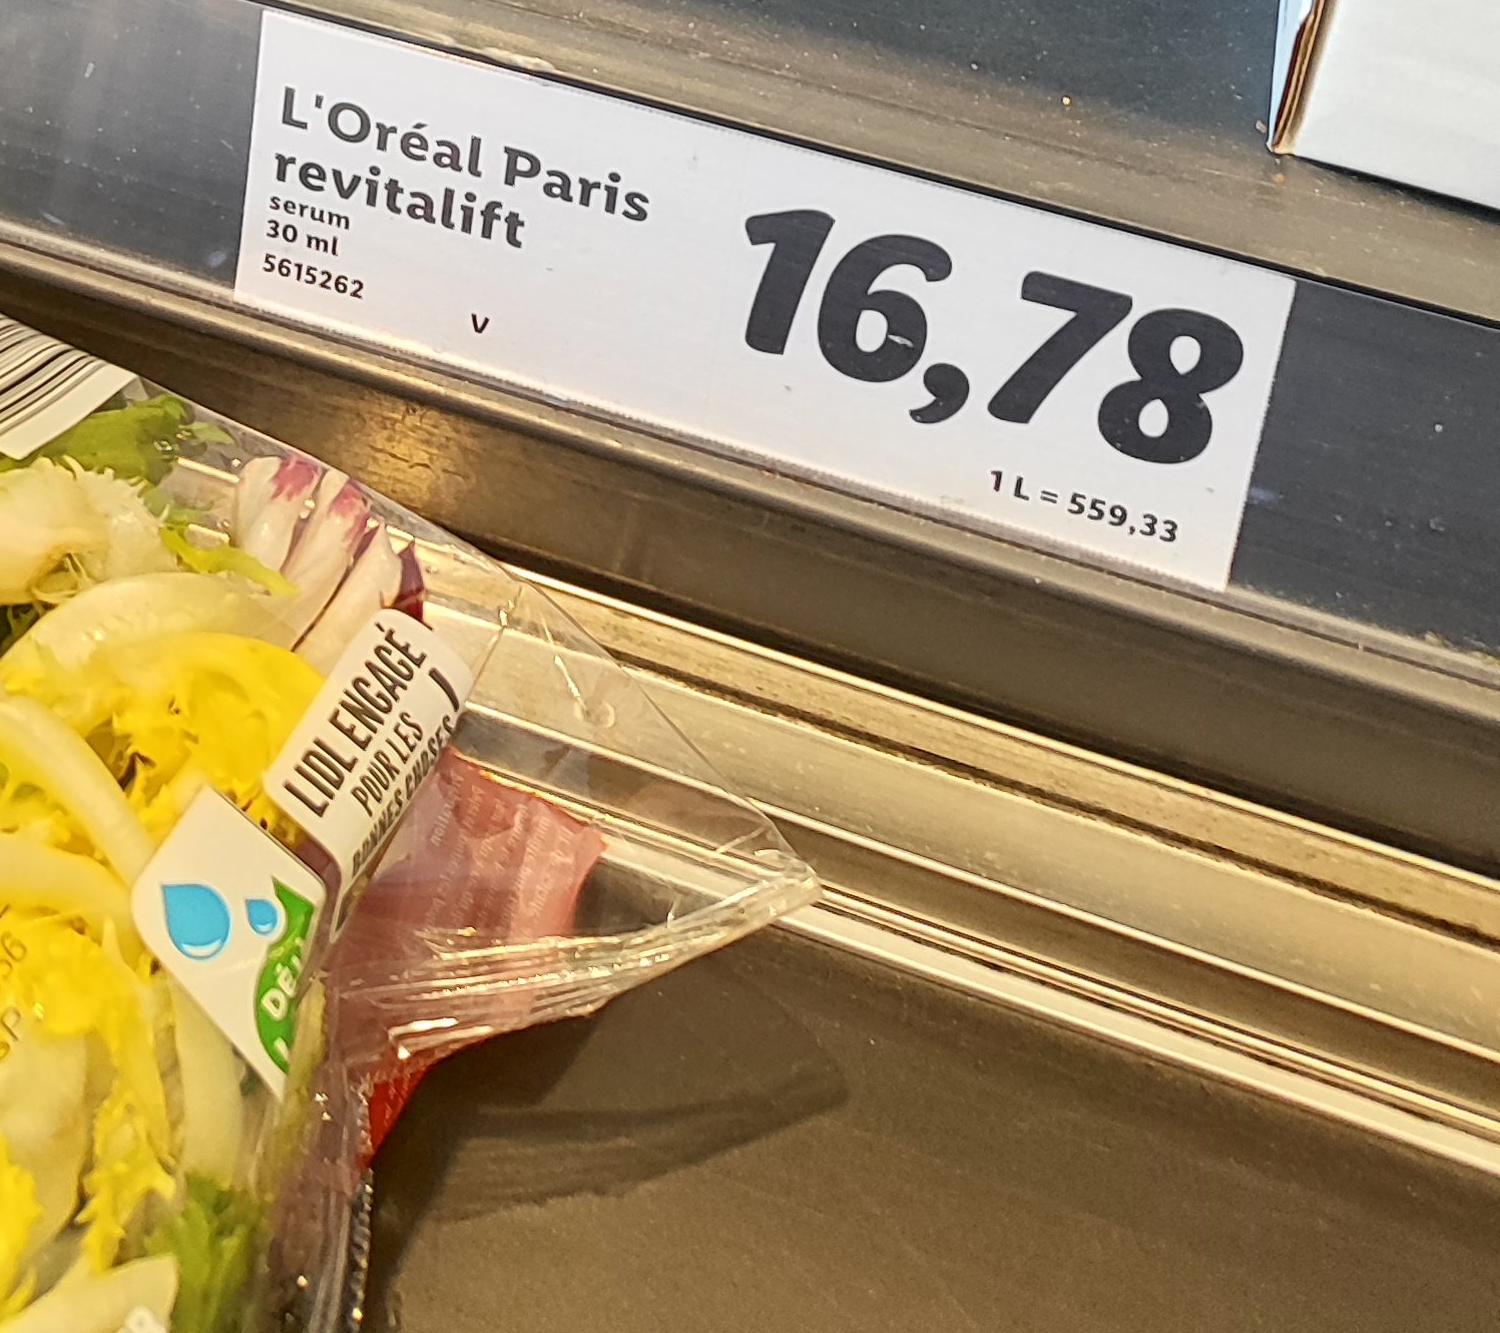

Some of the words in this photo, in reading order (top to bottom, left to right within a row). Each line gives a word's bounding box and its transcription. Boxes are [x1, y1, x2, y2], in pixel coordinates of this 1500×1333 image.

[274, 151, 525, 249] revitalift
[281, 85, 484, 178] L'Oréal
[502, 144, 651, 223] Paris
[266, 219, 298, 244] 30
[306, 232, 340, 258] ml
[269, 193, 350, 231] serum
[262, 253, 365, 301] 5615262
[744, 208, 1245, 465] 16,78
[989, 469, 1003, 493] 1
[1013, 475, 1030, 501] L
[1066, 490, 1180, 544] 559,33
[282, 736, 359, 819] LIDL
[328, 621, 428, 752] ENGAGÉ
[350, 749, 401, 818] POUR
[386, 711, 424, 765] LES
